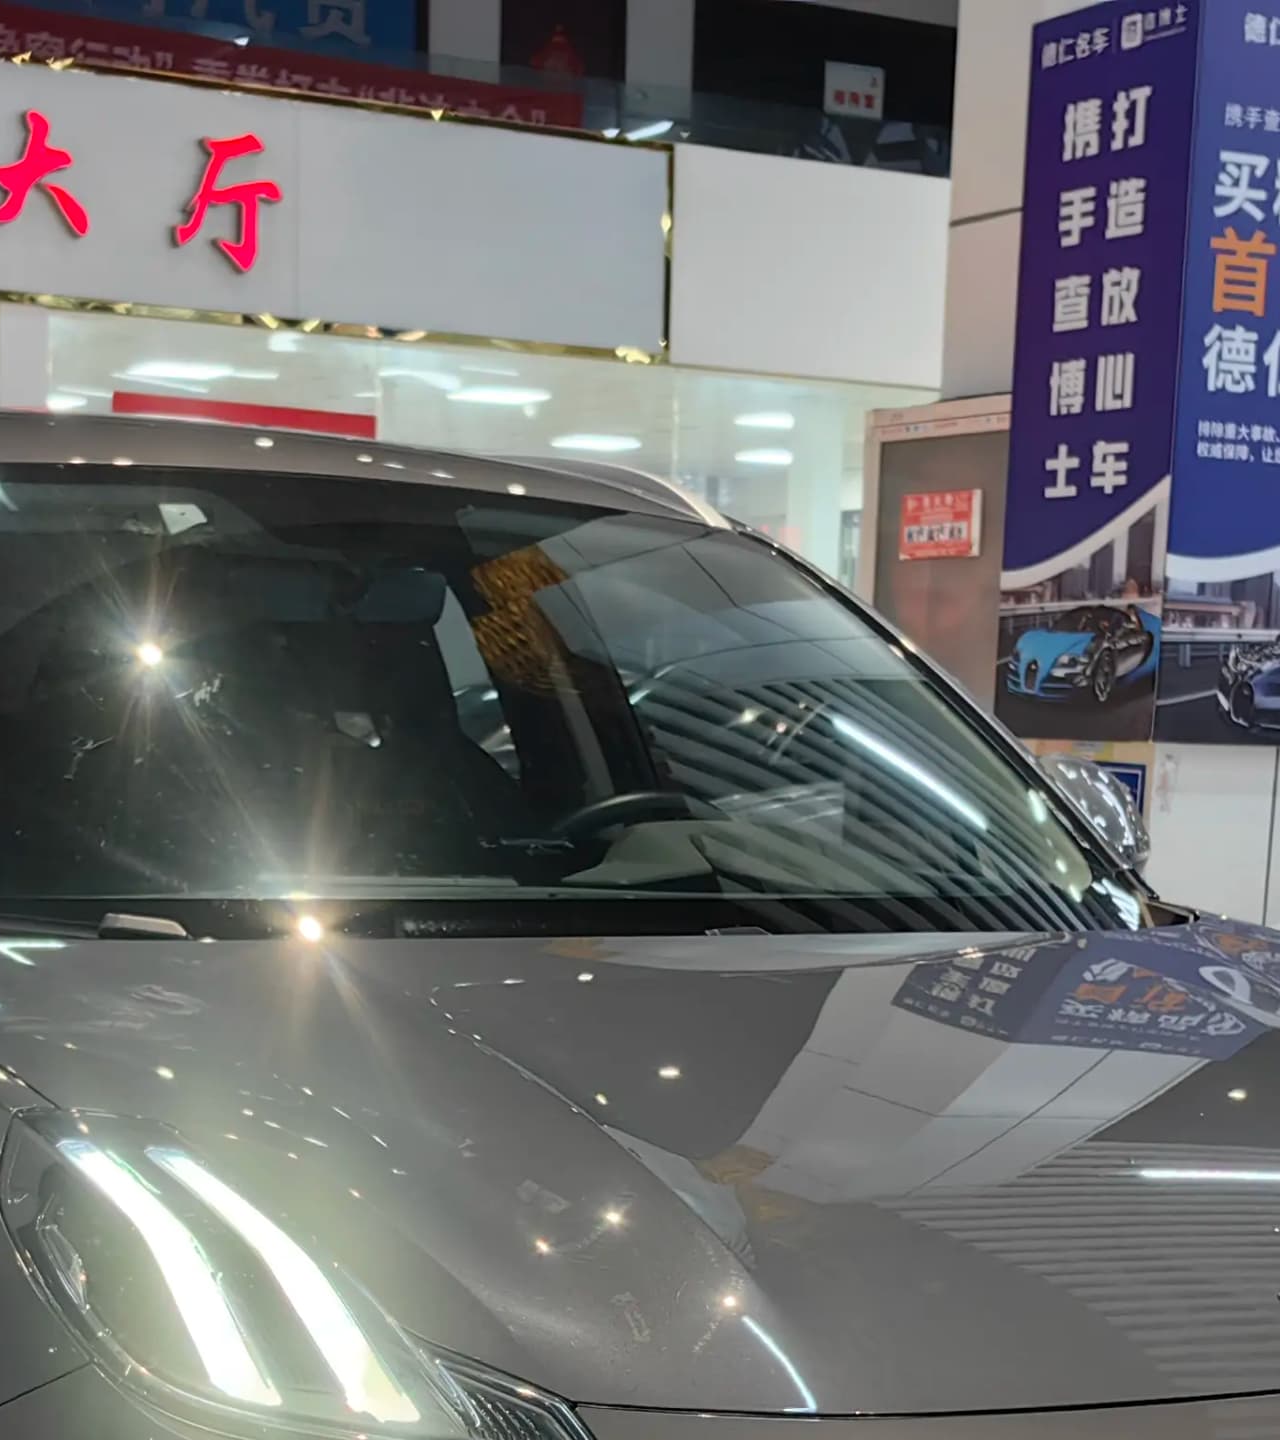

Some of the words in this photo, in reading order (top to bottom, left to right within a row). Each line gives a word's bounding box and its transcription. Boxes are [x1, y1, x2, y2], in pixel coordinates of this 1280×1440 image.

[1043, 98, 1102, 499] 携手查博士
[1090, 85, 1153, 495] 打造放心车
